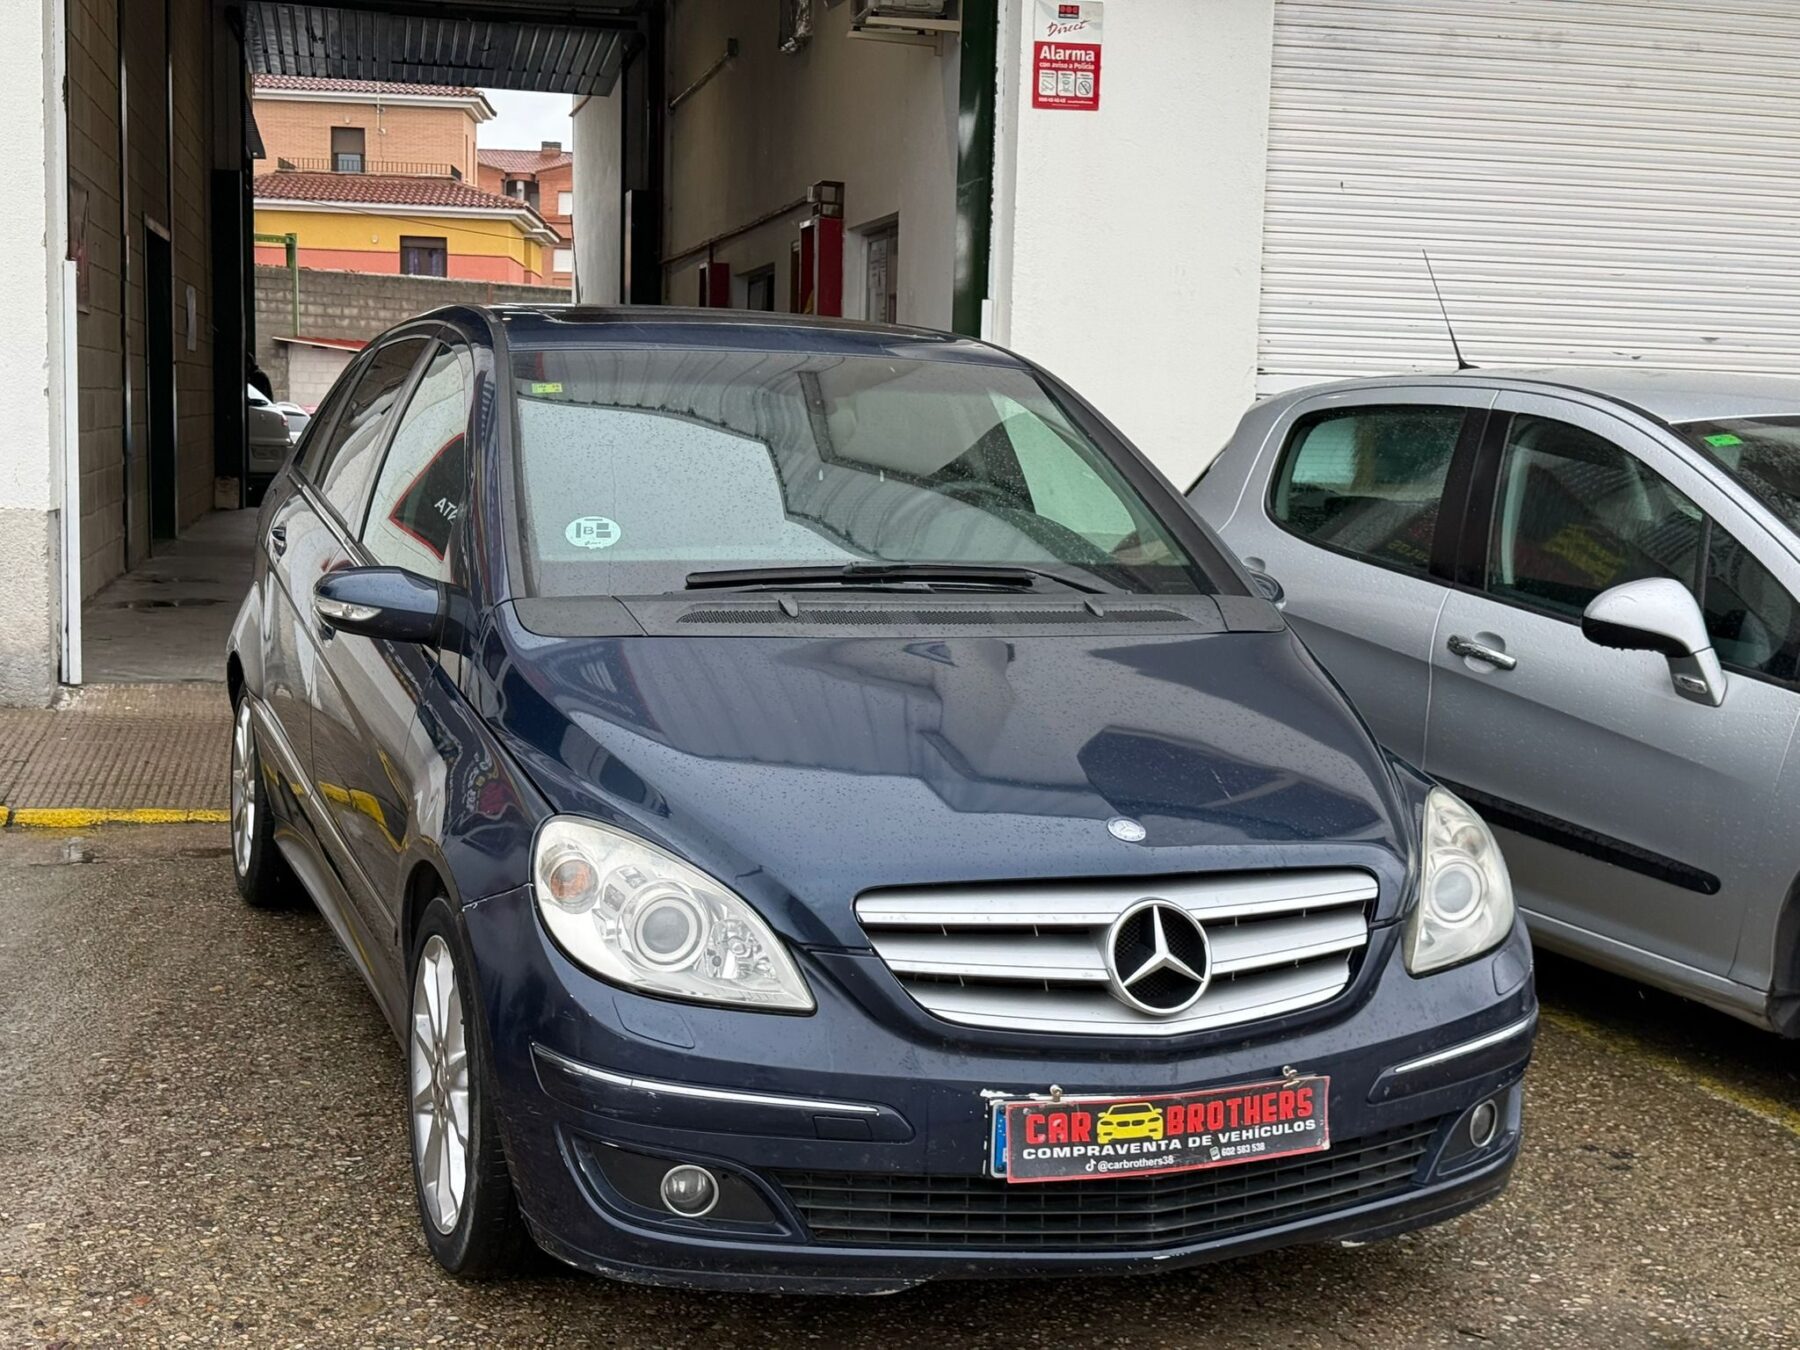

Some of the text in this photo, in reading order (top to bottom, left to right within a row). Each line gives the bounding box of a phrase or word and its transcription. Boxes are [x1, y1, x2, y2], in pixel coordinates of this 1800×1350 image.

[1047, 20, 1090, 36] Direct
[1040, 45, 1095, 62] Alarma
[583, 526, 595, 535] B
[1025, 1087, 1313, 1145] CAR BROTHERS
[1022, 1139, 1182, 1160] COMPRAVENTA
[1188, 1135, 1212, 1148] DE
[1218, 1119, 1317, 1144] VEHÍCULOS
[1097, 1154, 1175, 1172] @carbrothers38
